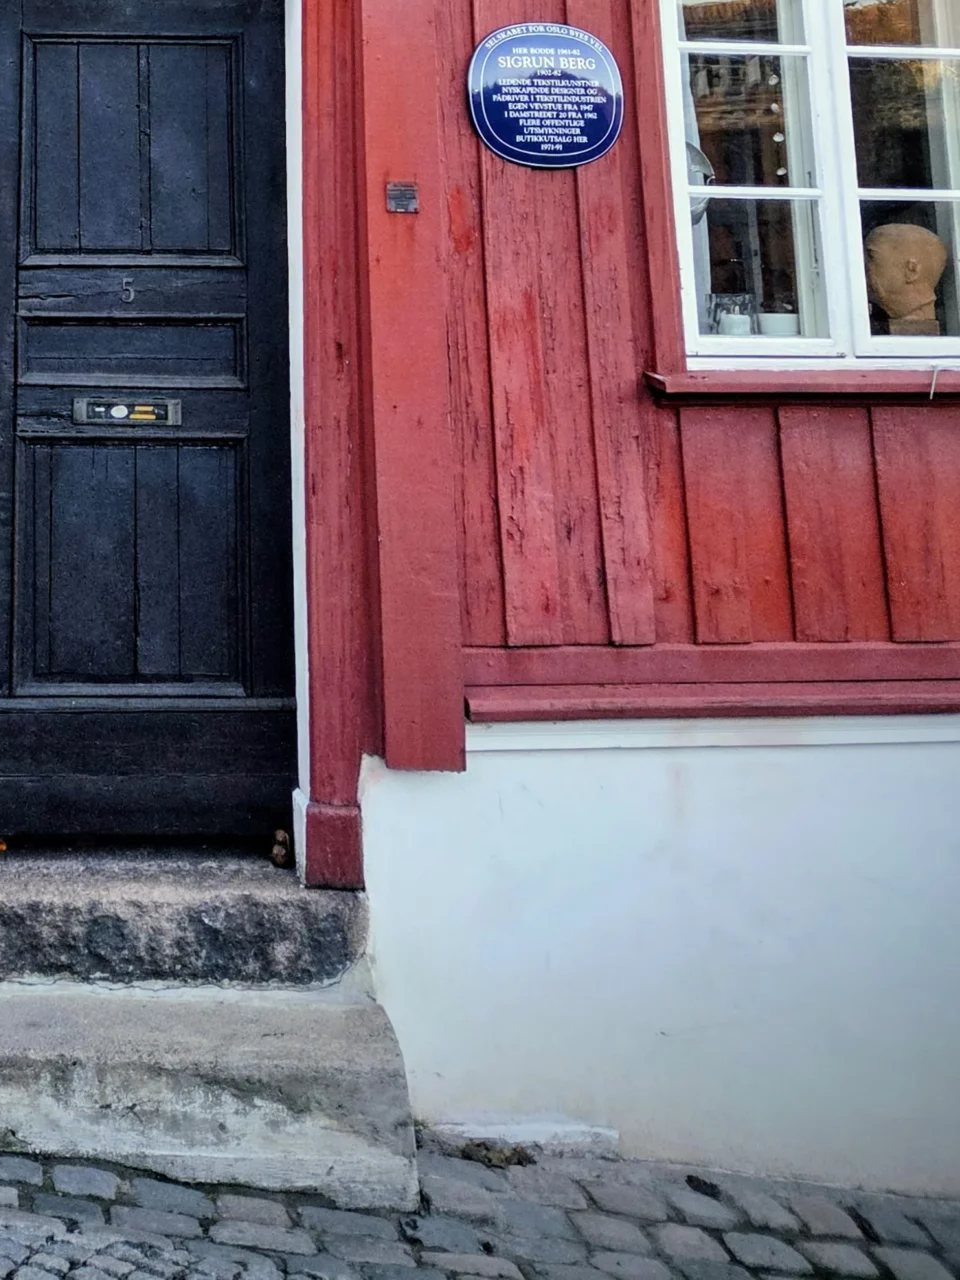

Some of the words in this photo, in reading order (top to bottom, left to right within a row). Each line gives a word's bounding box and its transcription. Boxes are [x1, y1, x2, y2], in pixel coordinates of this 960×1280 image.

[485, 26, 527, 49] SELSKABET
[546, 26, 568, 34] OSLO
[569, 29, 590, 42] BYES
[590, 38, 604, 52] VEL
[498, 57, 554, 68] SIGRUN
[560, 58, 595, 69] BERG
[533, 79, 600, 87] TEKSTILKUNSTNER
[493, 94, 528, 102] PÅDRIVER
[536, 95, 606, 103] TEKSTILINDUSTRIEN
[121, 277, 135, 303] 5
